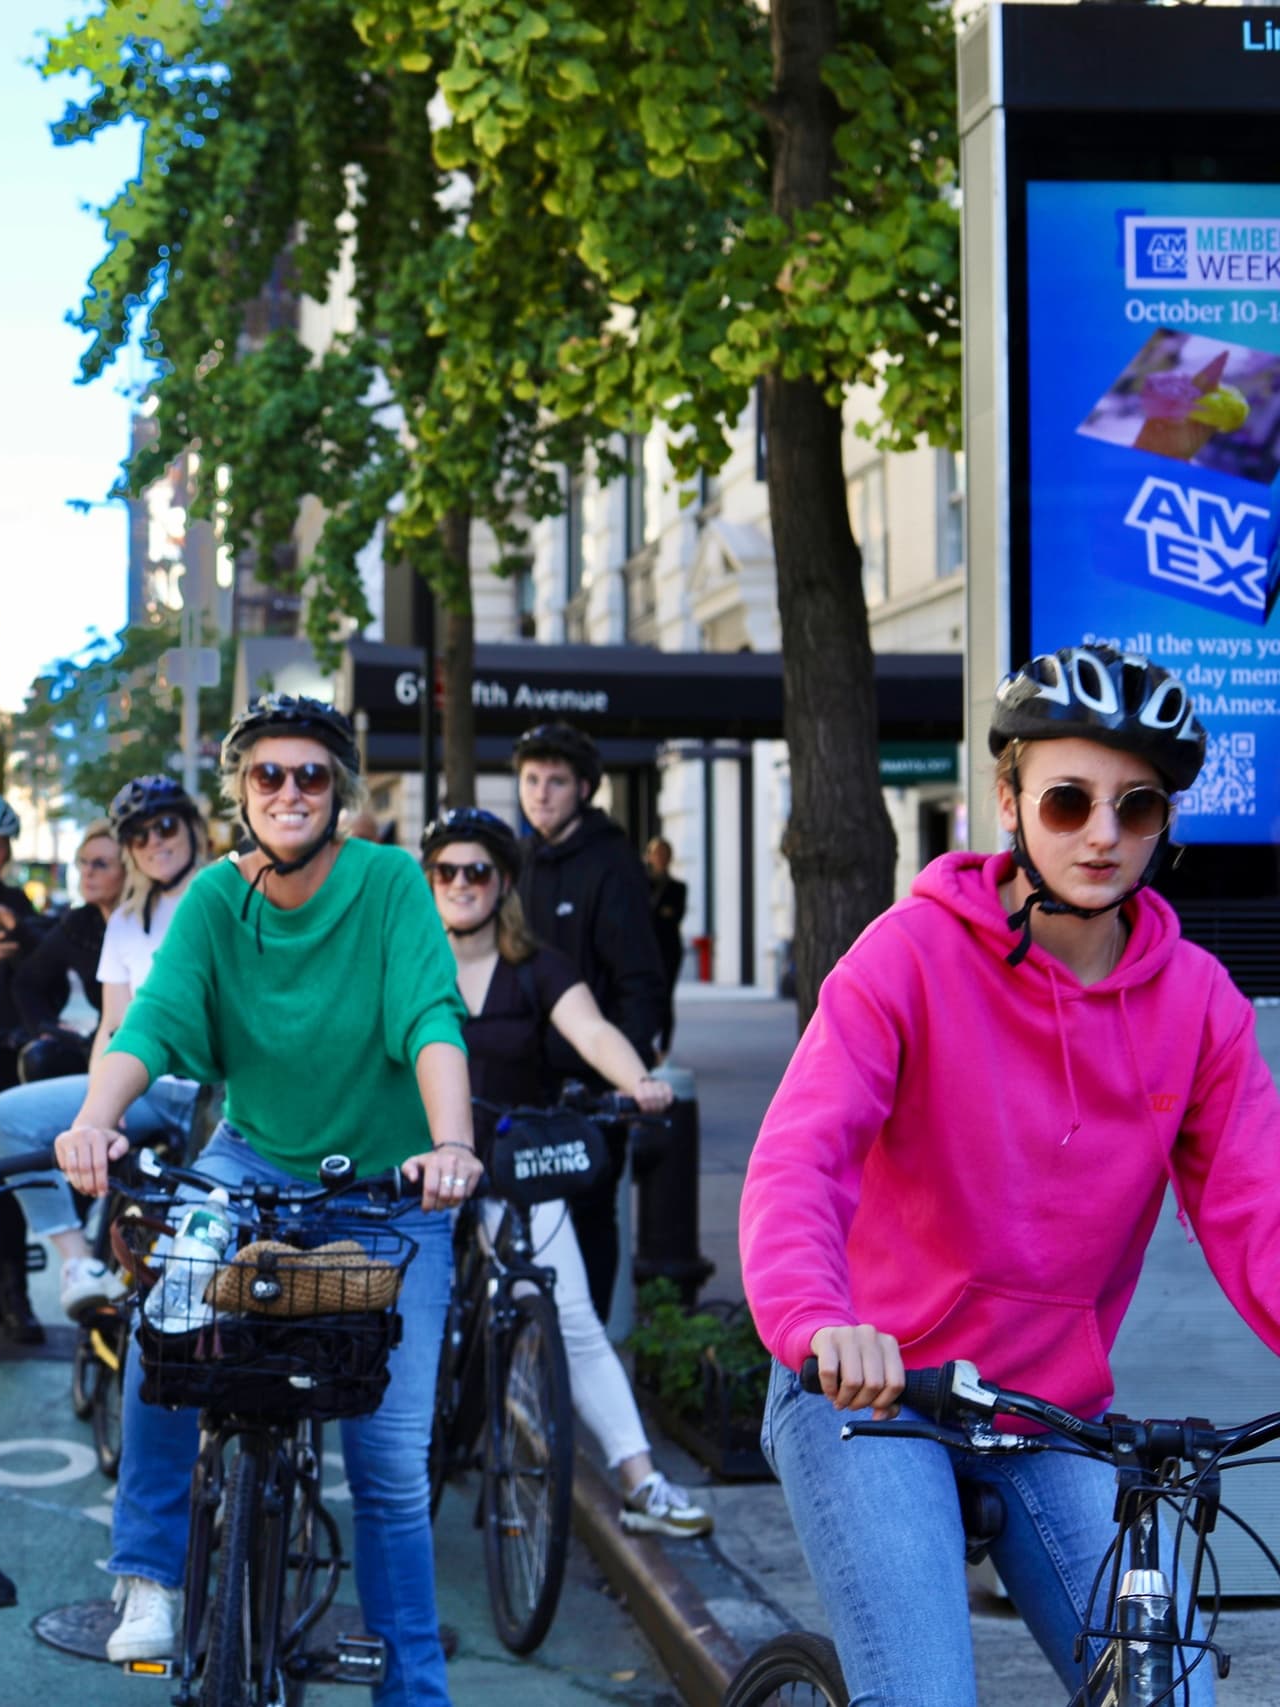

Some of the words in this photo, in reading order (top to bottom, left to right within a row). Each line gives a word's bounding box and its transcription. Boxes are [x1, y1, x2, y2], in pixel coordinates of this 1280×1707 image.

[1196, 226, 1280, 252] MEMBE
[1124, 298, 1224, 324] October
[1229, 300, 1280, 324] 10-1
[1124, 631, 1152, 654] all
[1157, 633, 1192, 654] the
[1198, 637, 1252, 659] ways
[1186, 663, 1227, 689] day
[514, 686, 609, 712] Avenue
[515, 1153, 590, 1180] BIKING
